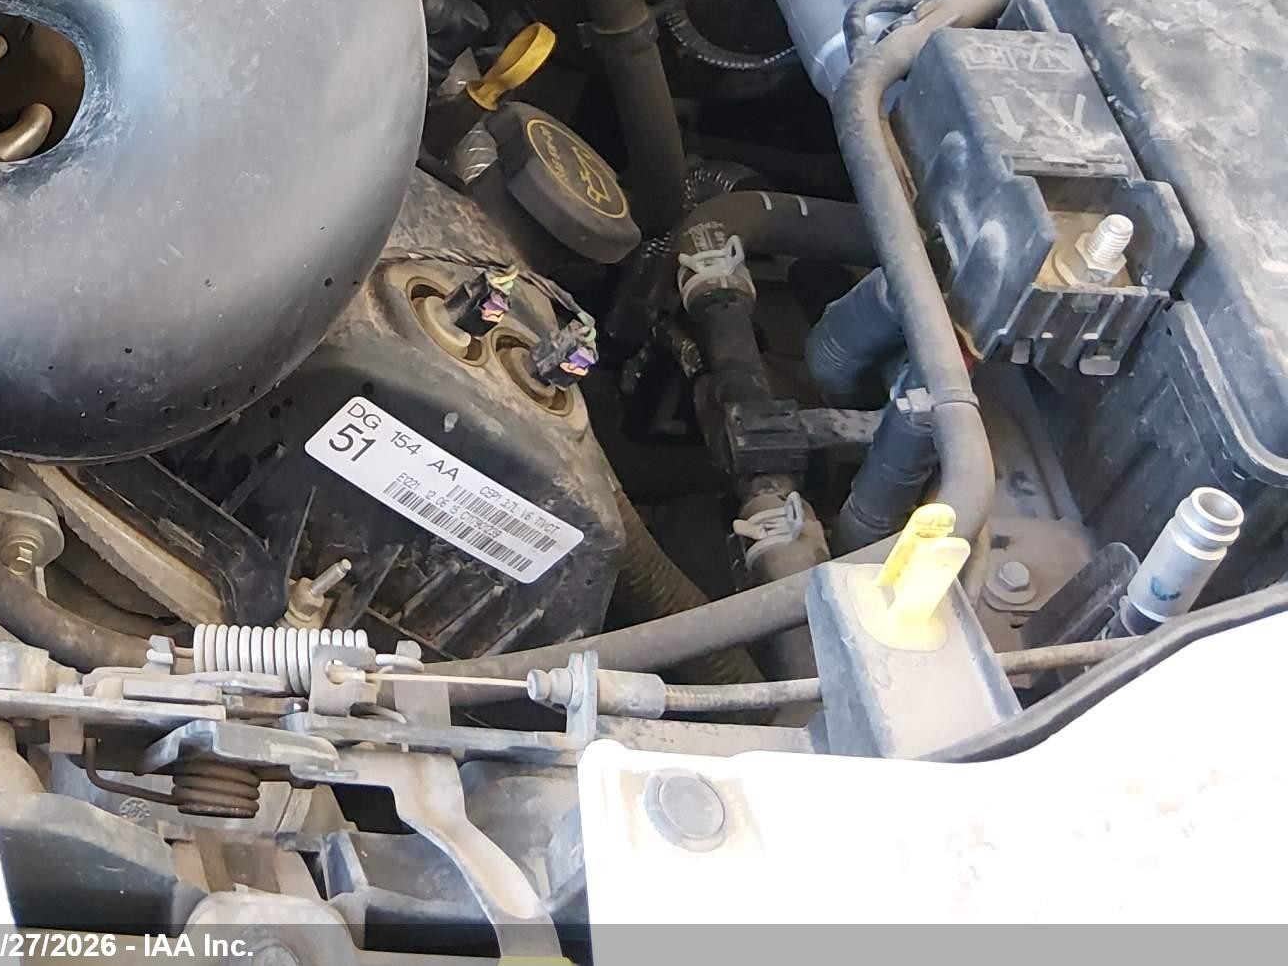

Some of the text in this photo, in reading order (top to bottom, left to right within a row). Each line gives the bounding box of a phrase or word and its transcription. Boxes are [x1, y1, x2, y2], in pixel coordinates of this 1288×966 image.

[328, 423, 377, 462] 51
[347, 402, 459, 481] DG 154 AA
